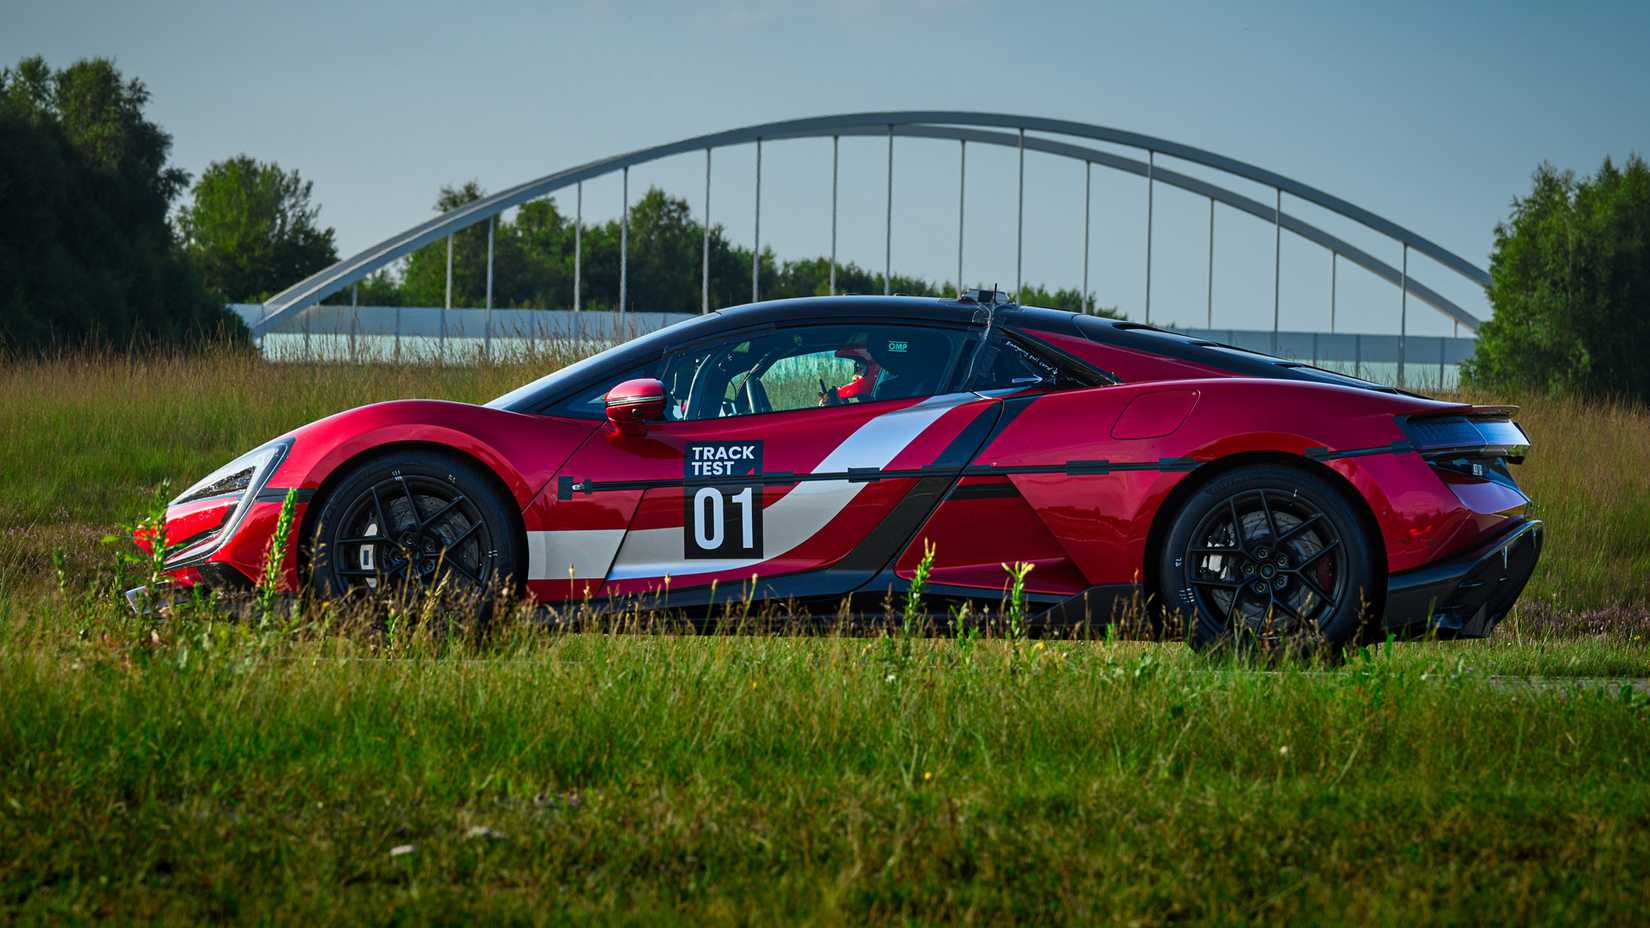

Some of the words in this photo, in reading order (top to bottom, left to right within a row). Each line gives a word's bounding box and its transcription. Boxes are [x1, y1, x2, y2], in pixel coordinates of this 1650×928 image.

[888, 341, 908, 351] OMP
[692, 445, 755, 460] TRACK
[691, 461, 735, 475] TEST
[694, 487, 753, 550] 01
